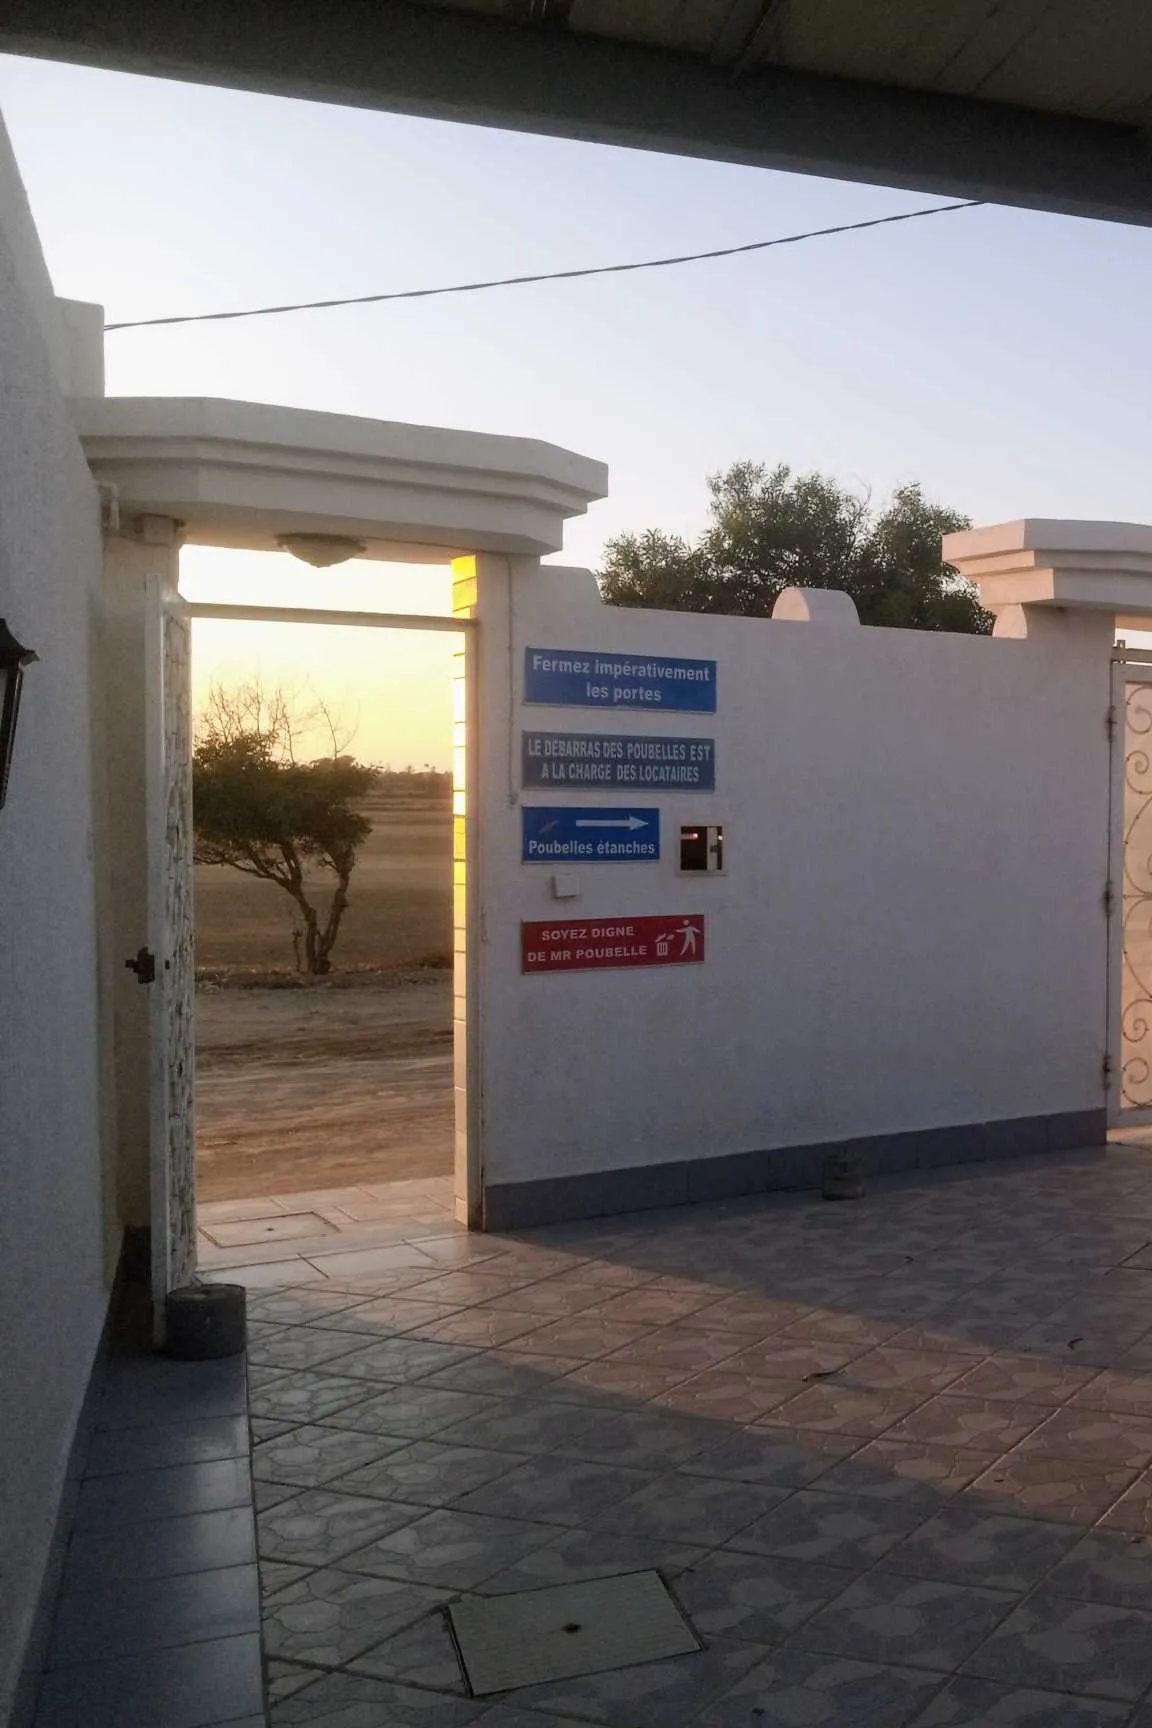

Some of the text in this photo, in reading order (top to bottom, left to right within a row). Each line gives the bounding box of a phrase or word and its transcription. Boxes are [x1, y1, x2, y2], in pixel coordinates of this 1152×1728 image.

[533, 655, 710, 681] Fermez impérativement
[586, 682, 662, 702] les portes
[528, 738, 541, 756] LE
[603, 742, 624, 758] DES
[627, 743, 686, 761] POUBELLES
[690, 745, 711, 761] EST
[552, 763, 565, 780] LA
[568, 763, 611, 780] CHARGE
[617, 765, 636, 781] DES
[639, 765, 700, 782] LOCATAIRES
[529, 840, 655, 854] Poubelles étanches
[542, 926, 635, 941] SOYEZ DIGNE
[527, 945, 647, 962] DE MR POUBELLE
